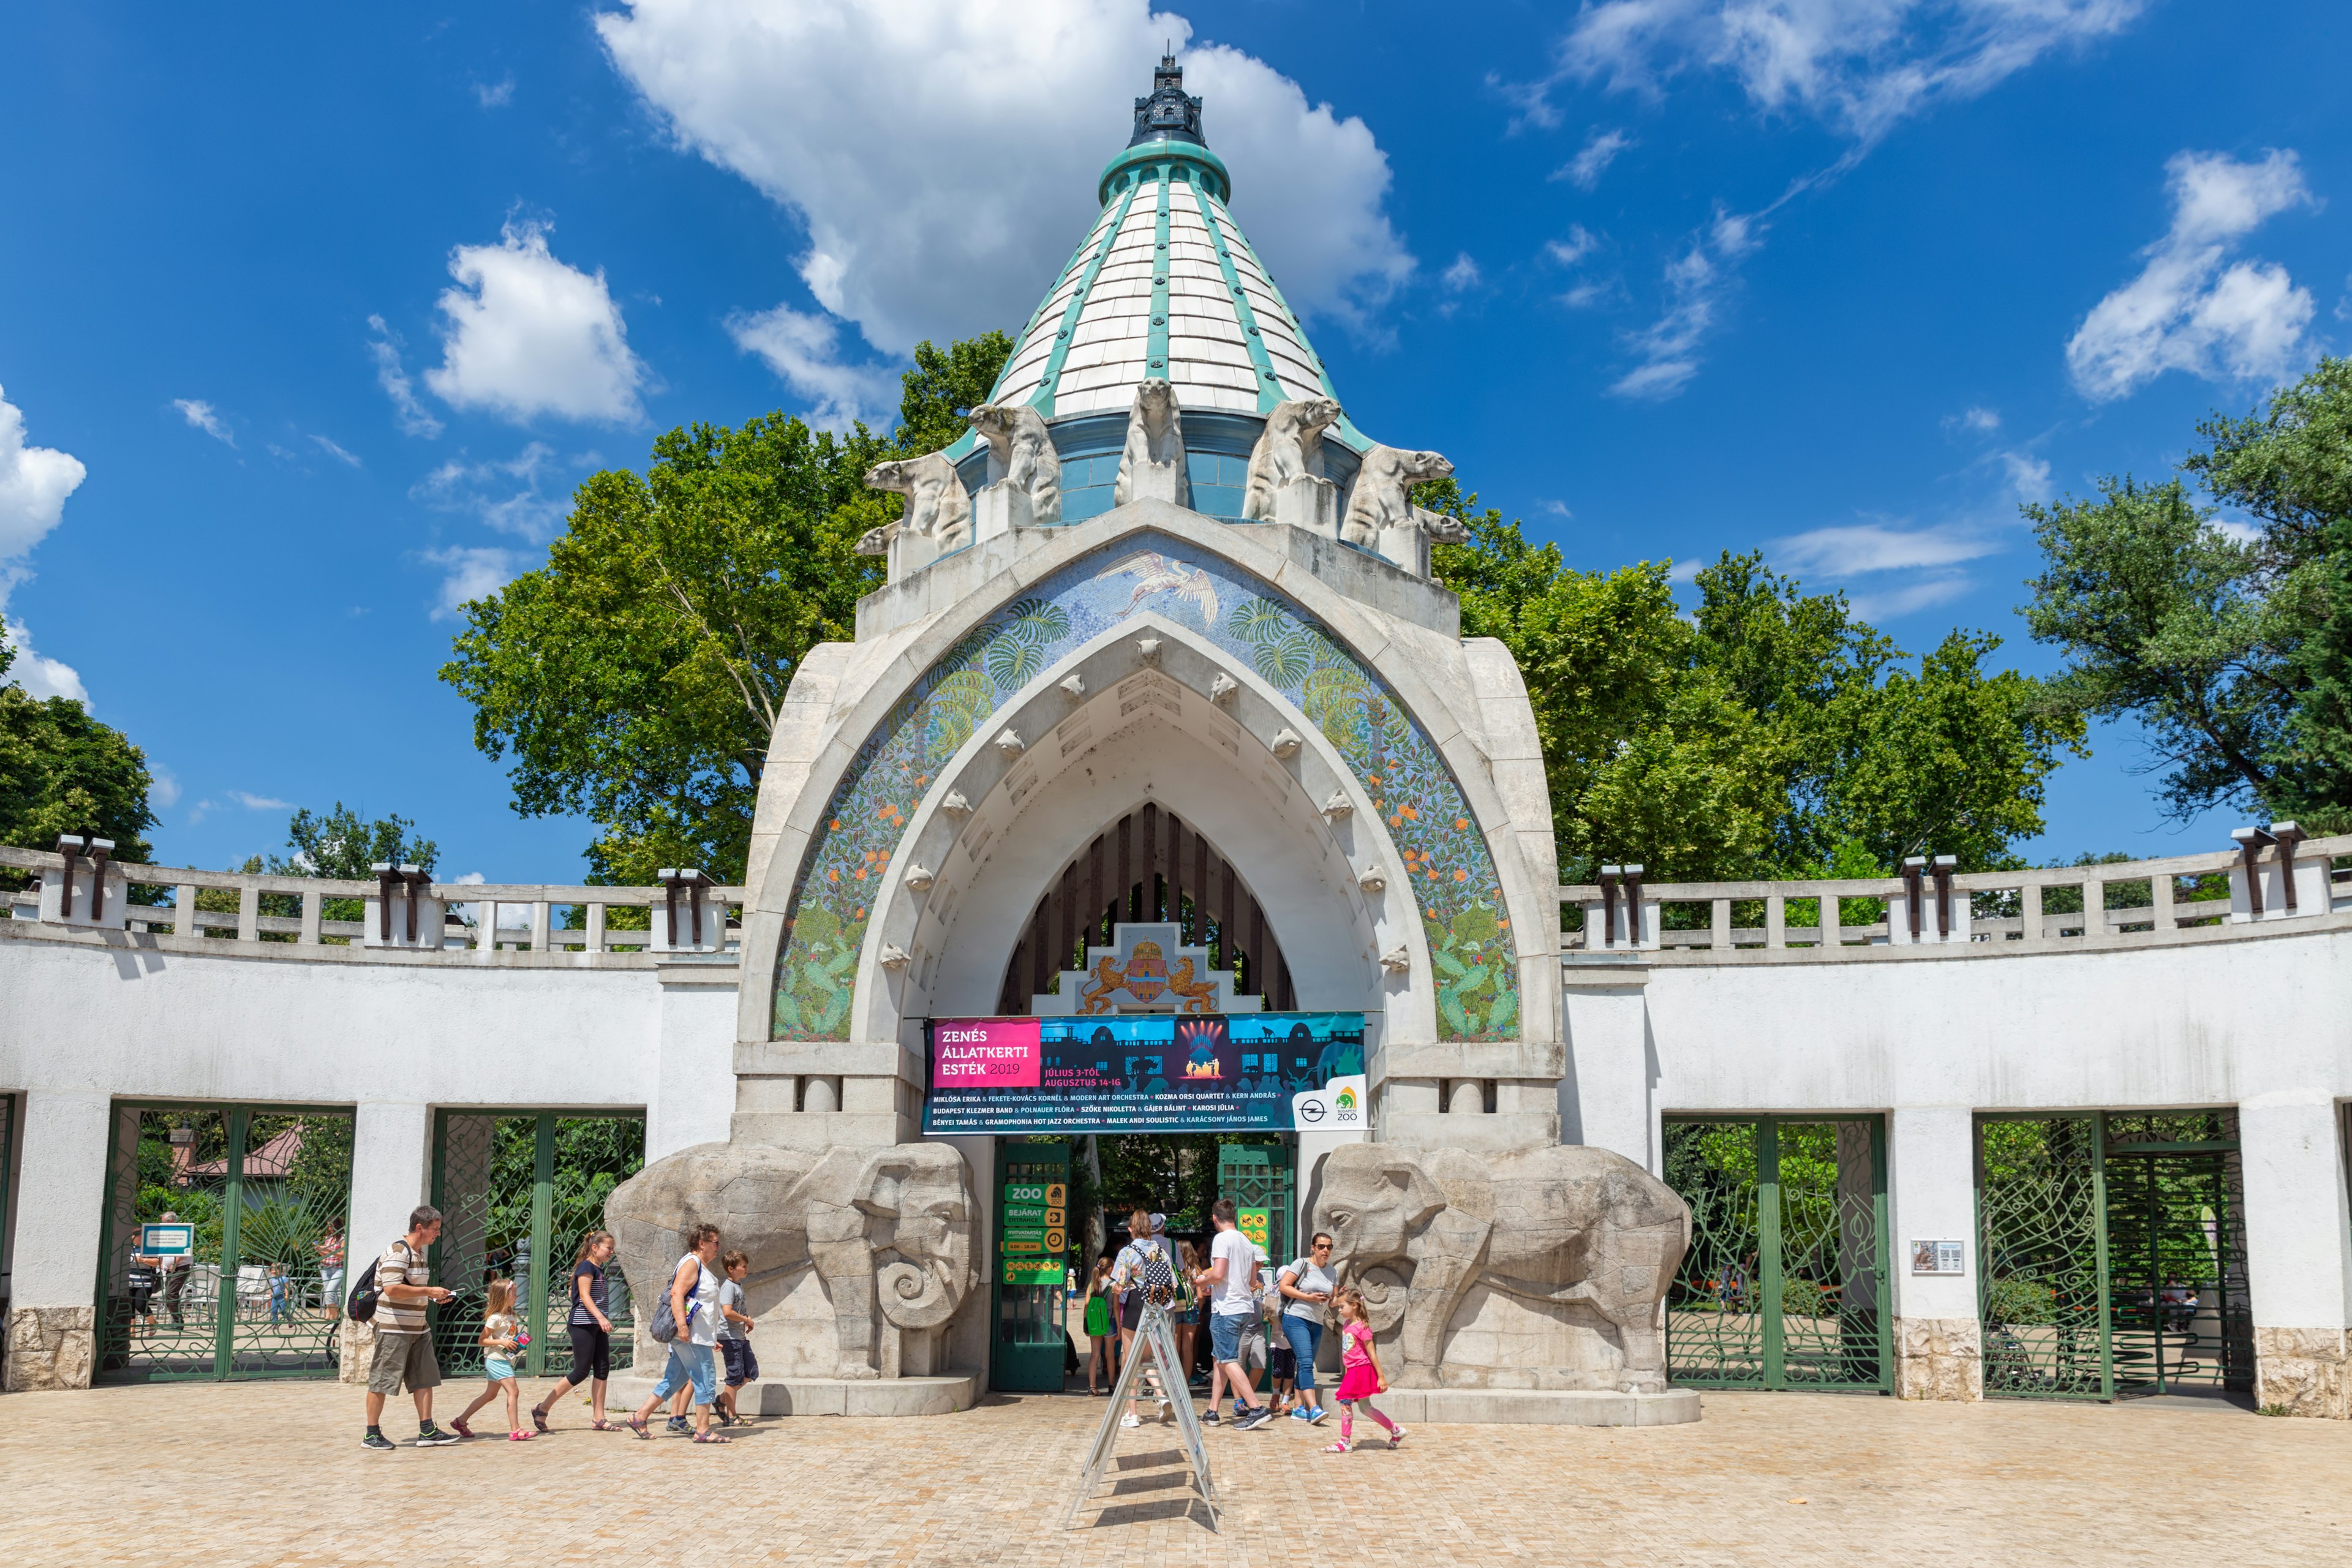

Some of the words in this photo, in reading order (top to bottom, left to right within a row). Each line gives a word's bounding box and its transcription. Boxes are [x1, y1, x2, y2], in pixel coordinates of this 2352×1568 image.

[942, 1028, 987, 1042] ZENÉS
[942, 1045, 1028, 1059] ÁLLATKERTI
[942, 1061, 986, 1075] ESTÉK
[990, 1064, 1020, 1074] 2019
[1045, 1068, 1074, 1078] JÚLIUS
[1076, 1067, 1100, 1076] 3-TÓL
[1218, 1103, 1234, 1112] JÚLIA
[1012, 1188, 1042, 1199] ZOO
[1009, 1208, 1042, 1216] BEJÁRAT
